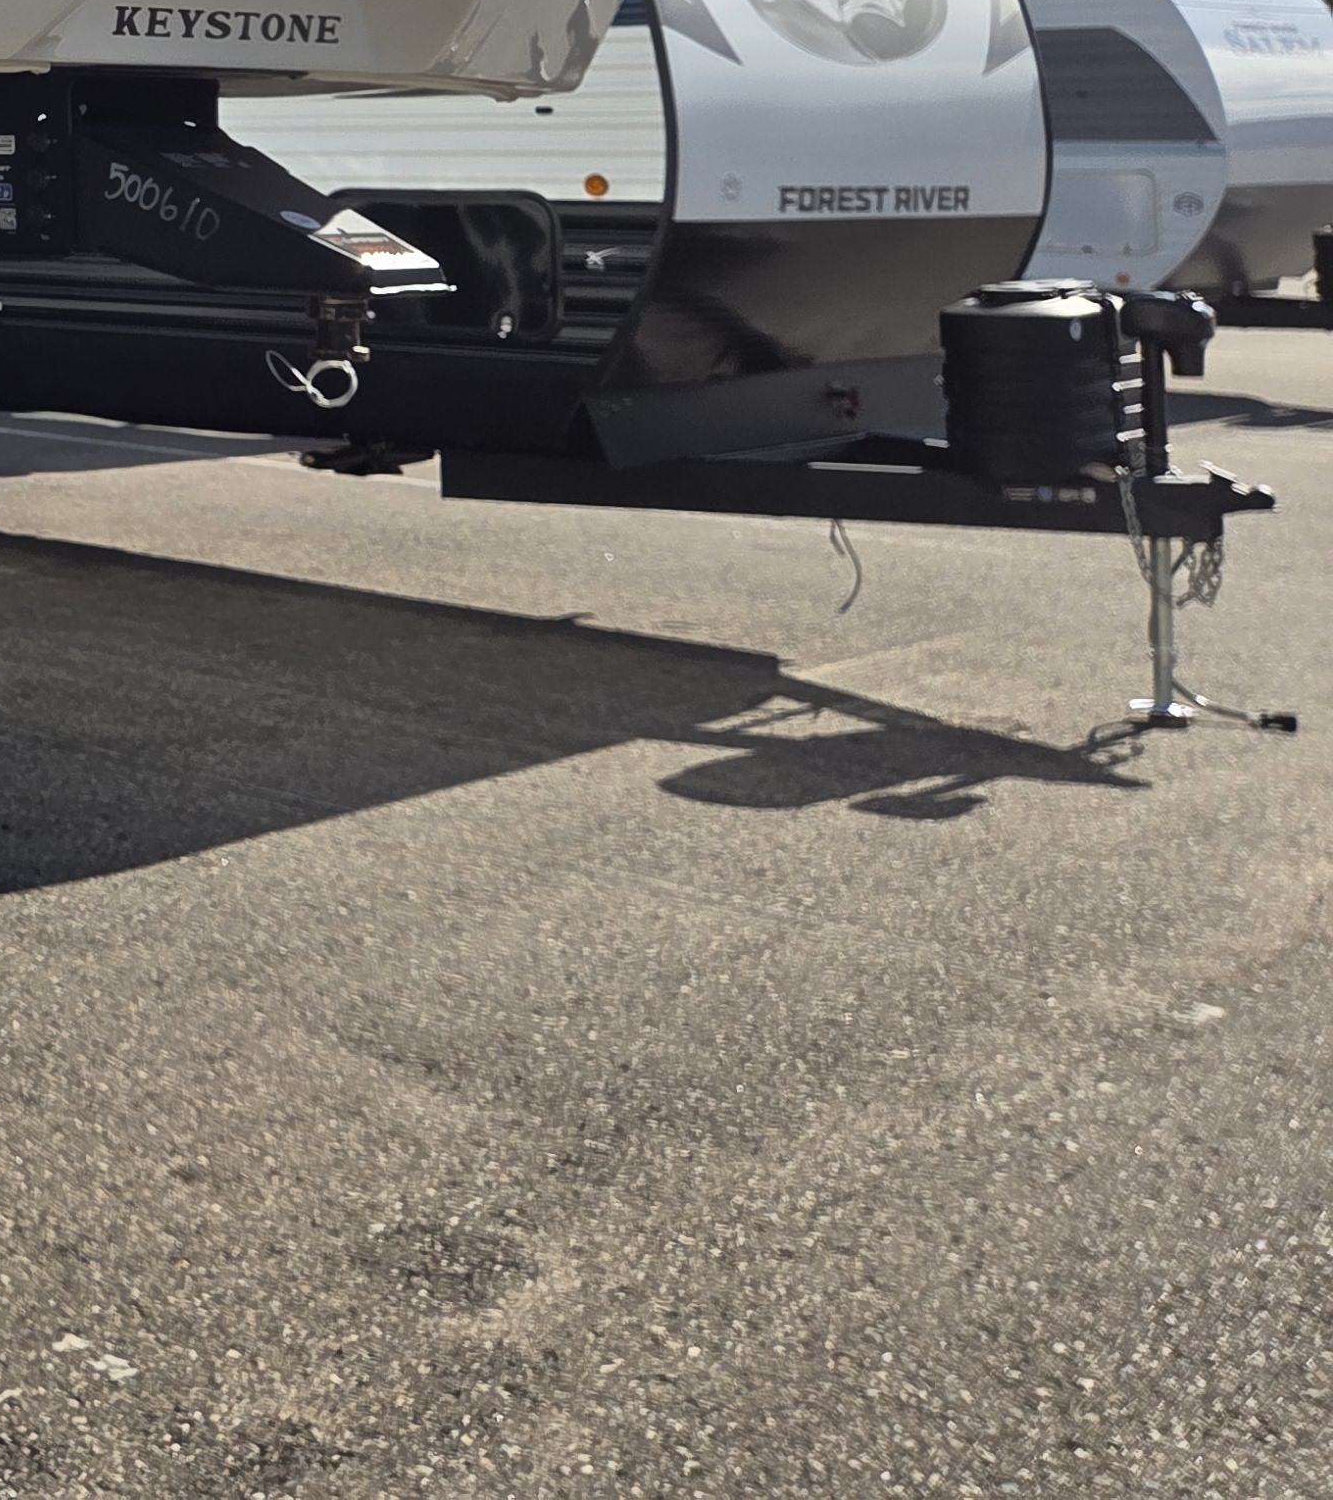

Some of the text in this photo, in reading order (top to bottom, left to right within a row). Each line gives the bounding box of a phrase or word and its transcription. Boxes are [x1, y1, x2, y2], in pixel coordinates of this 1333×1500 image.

[112, 5, 342, 44] KEYSTONE
[104, 162, 220, 240] 500610
[778, 185, 970, 212] FOREST RIVER
